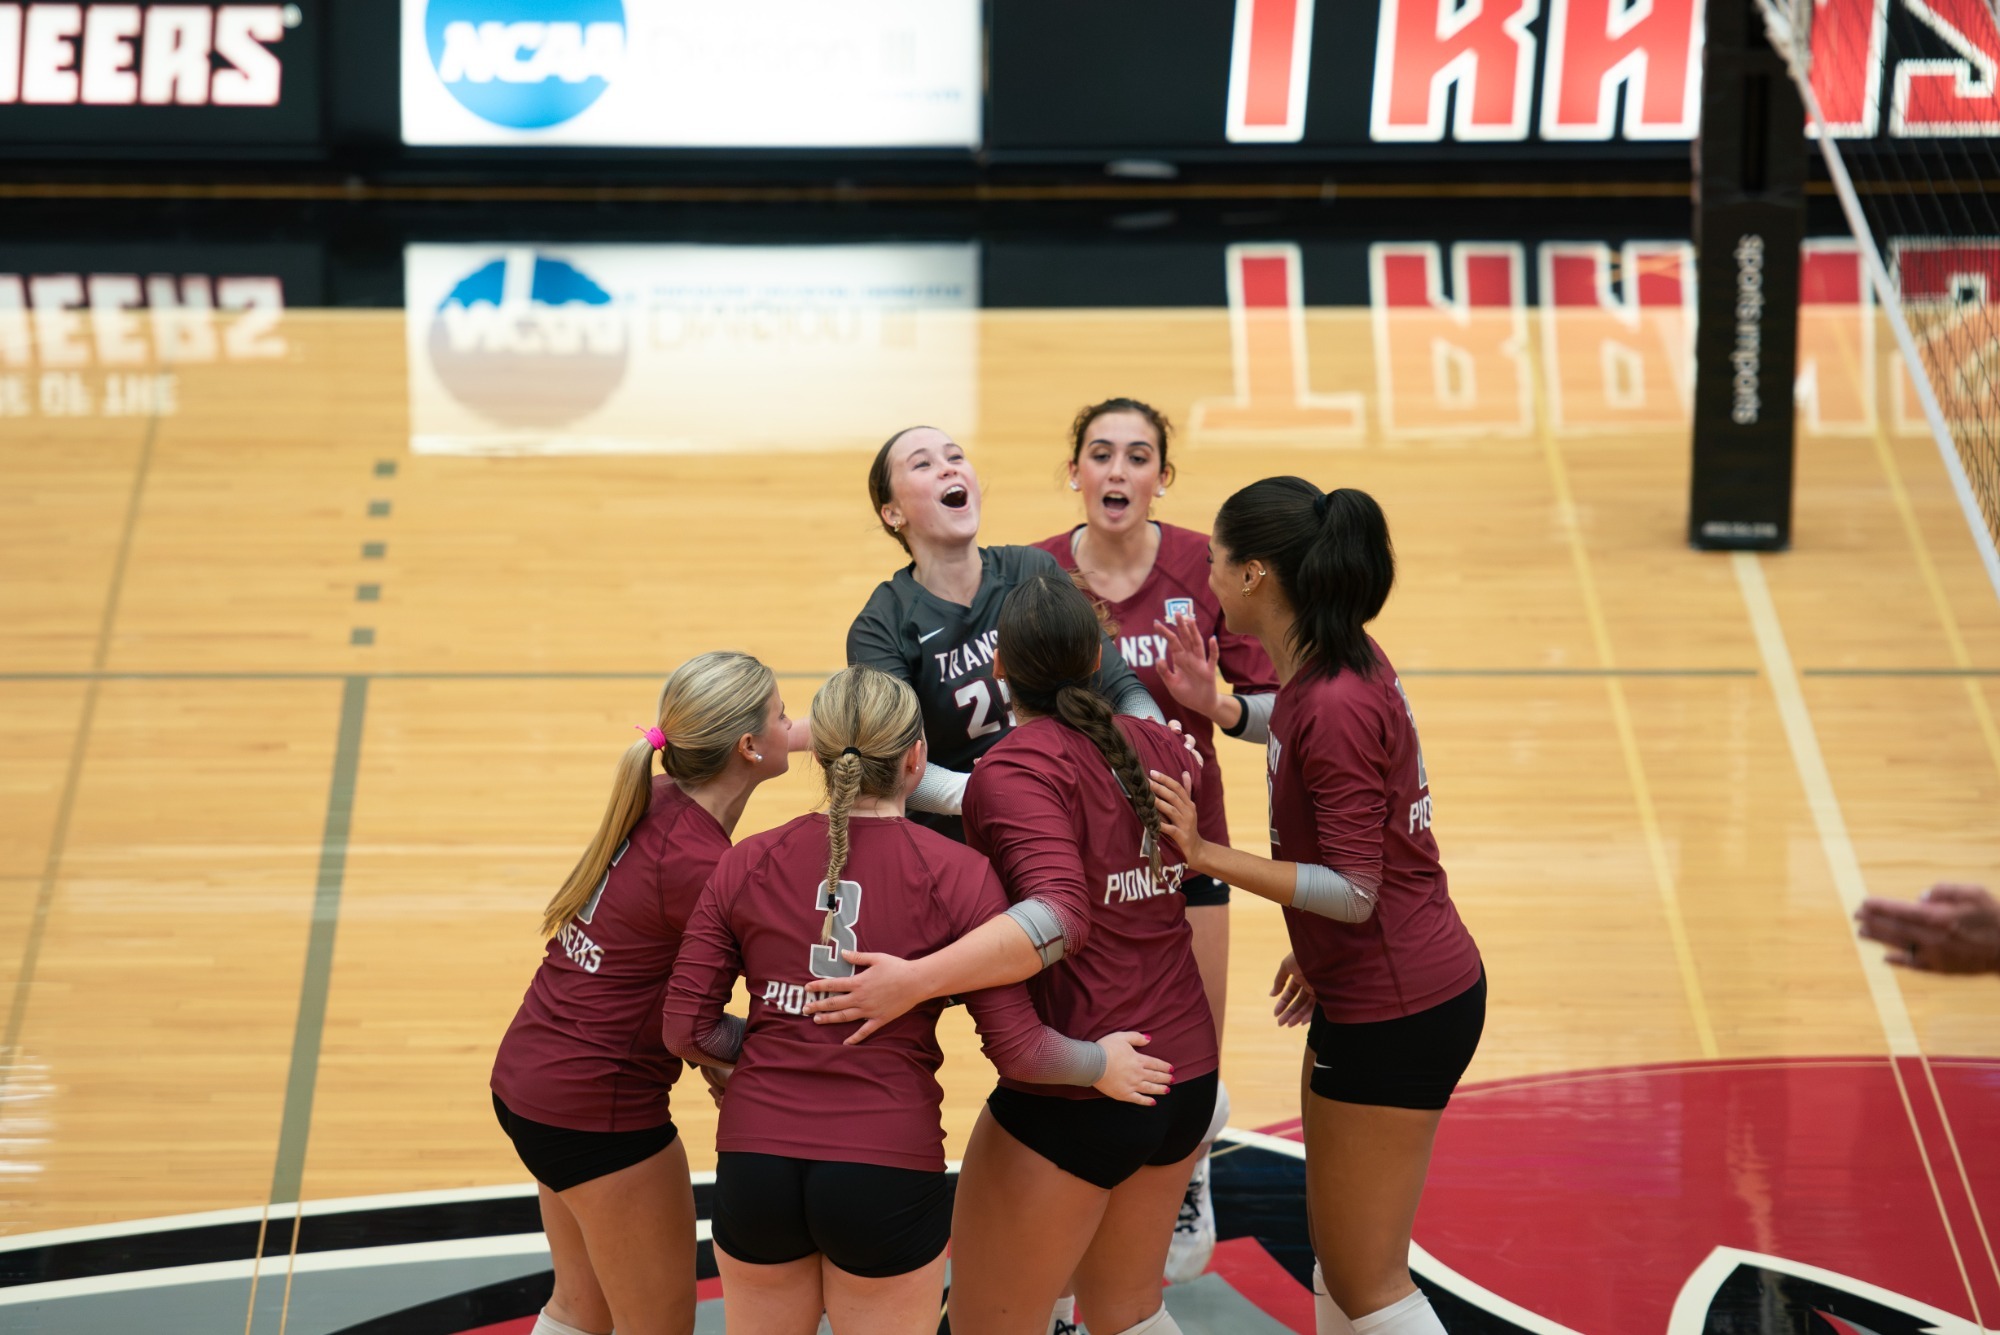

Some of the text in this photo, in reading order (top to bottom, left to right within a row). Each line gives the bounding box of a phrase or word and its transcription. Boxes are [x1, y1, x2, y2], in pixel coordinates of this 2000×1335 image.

[0, 4, 283, 104] EERS
[439, 21, 626, 83] NCAA
[809, 878, 862, 979] 3
